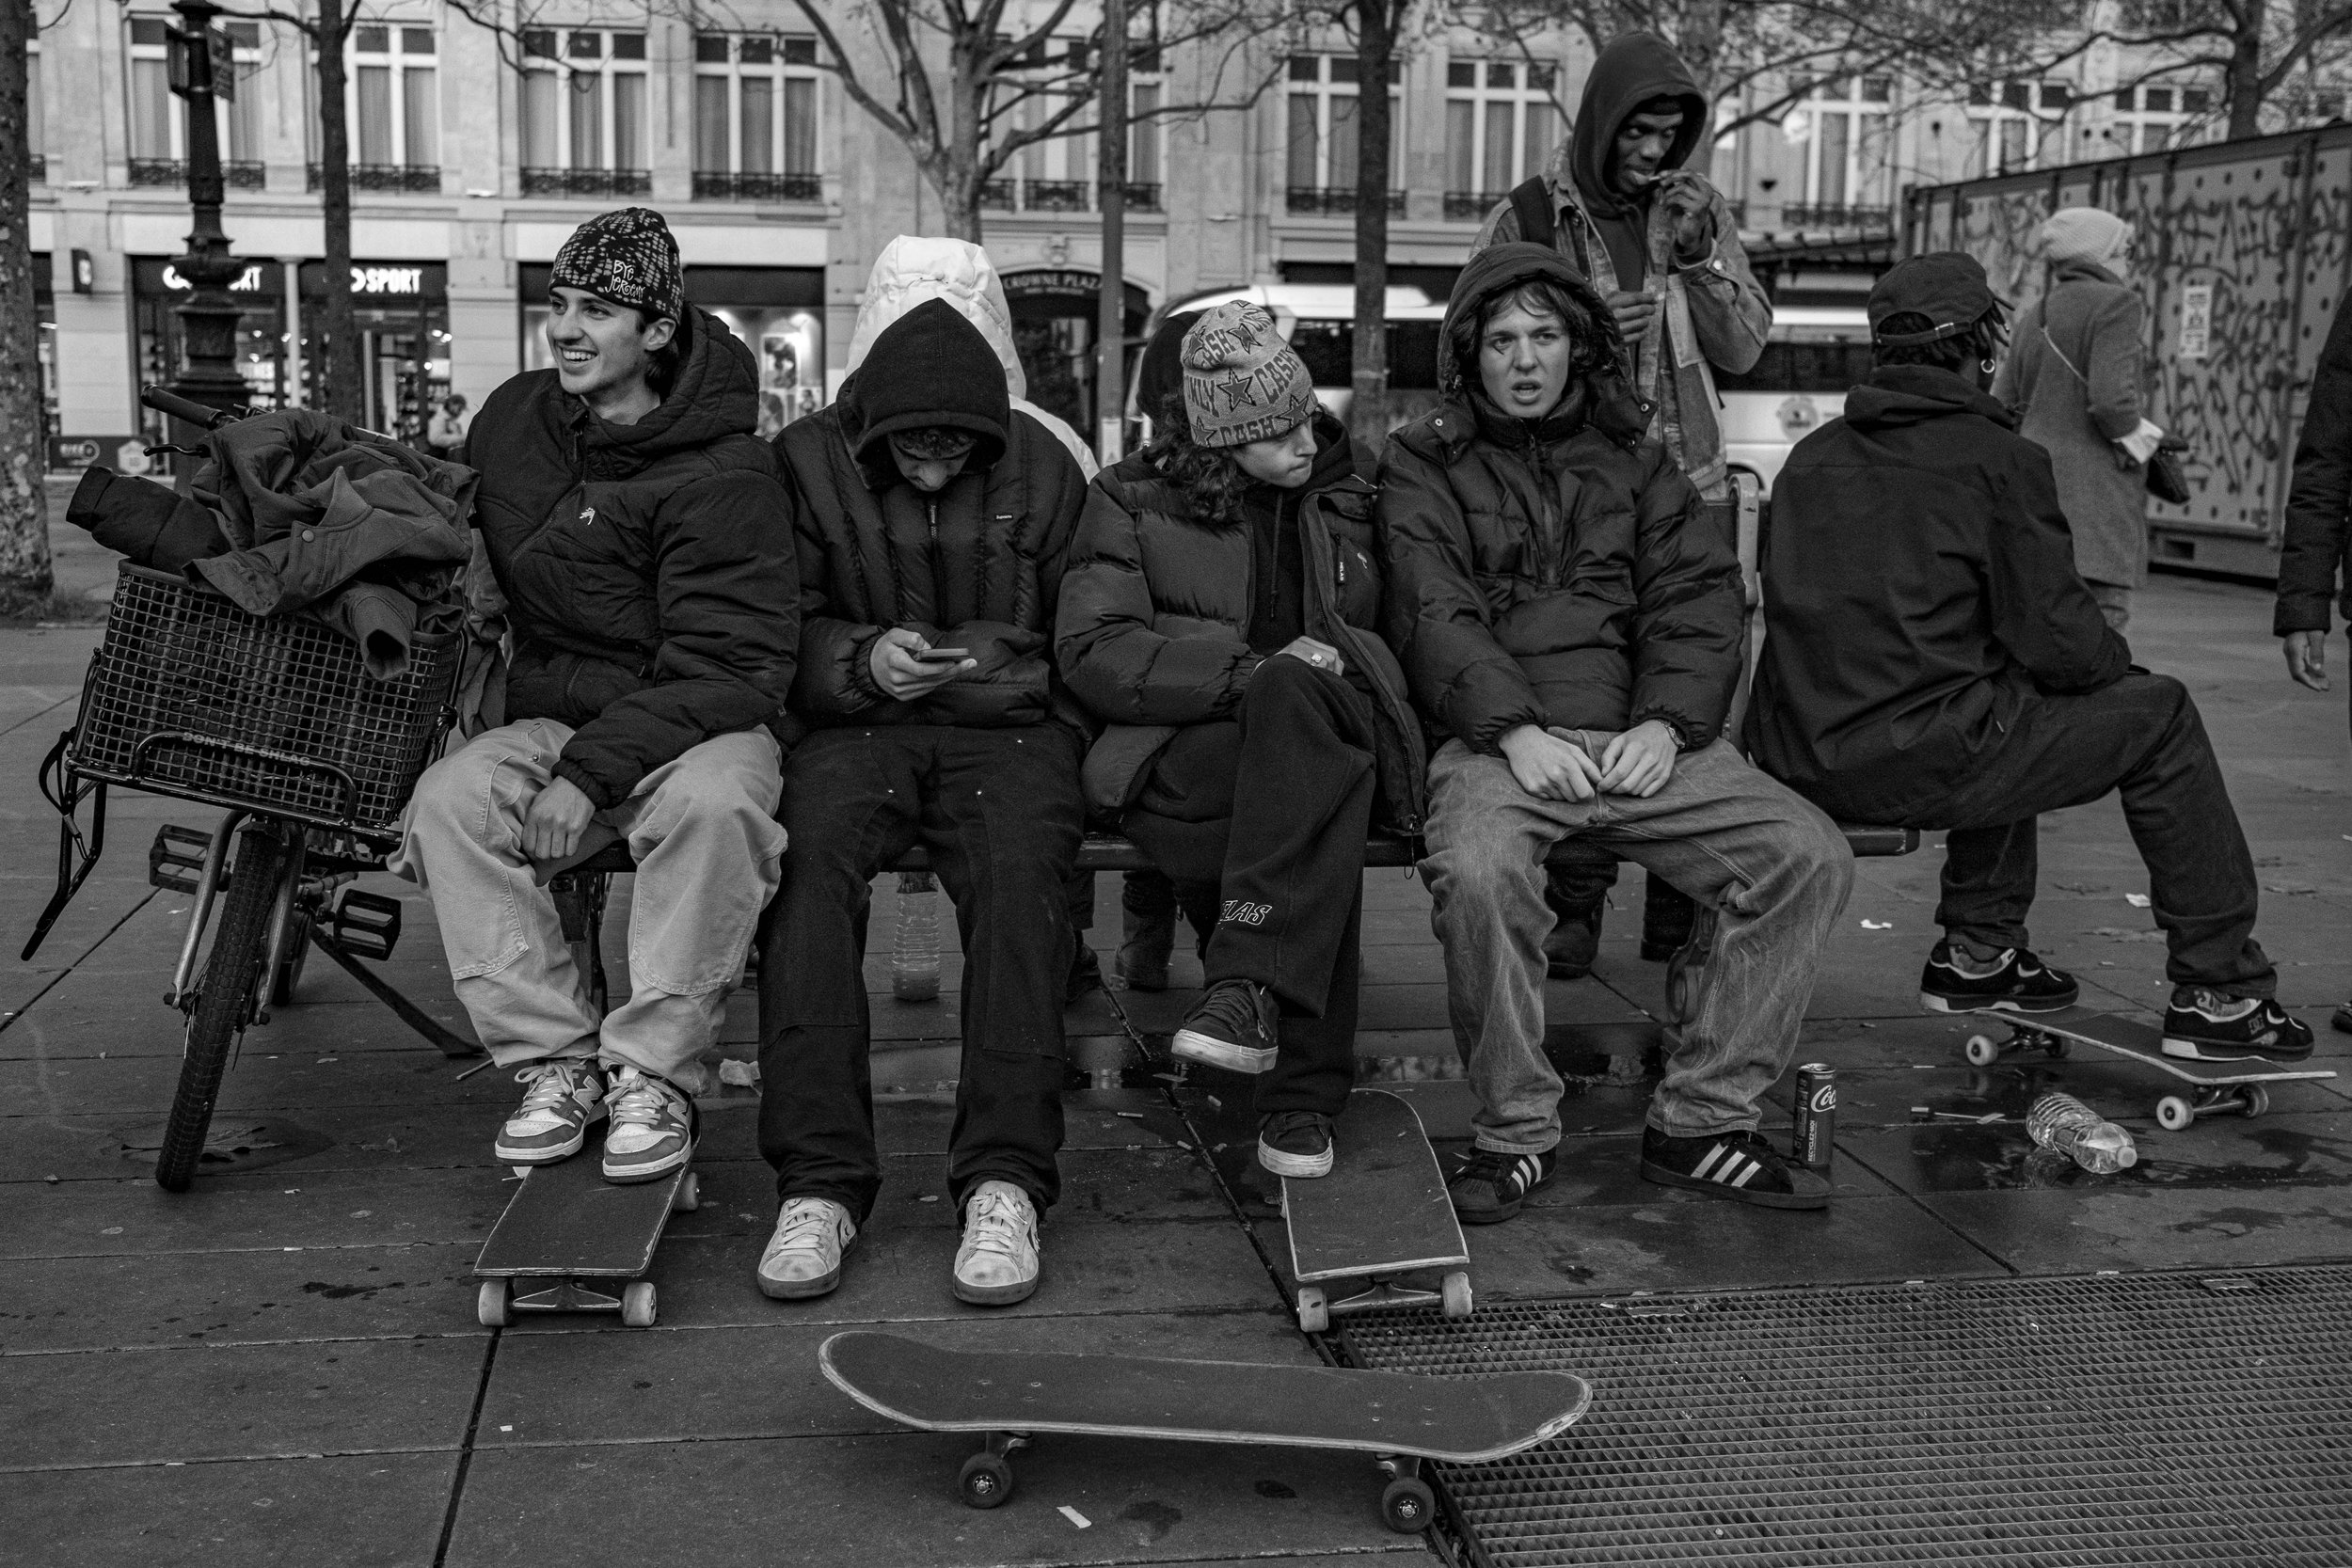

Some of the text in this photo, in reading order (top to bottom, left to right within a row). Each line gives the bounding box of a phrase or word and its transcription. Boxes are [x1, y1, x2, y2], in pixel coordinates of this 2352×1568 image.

[366, 268, 422, 293] SPORT
[1063, 274, 1103, 290] PLAZ
[1254, 349, 1300, 404] CASH
[1219, 415, 1277, 445] CASH
